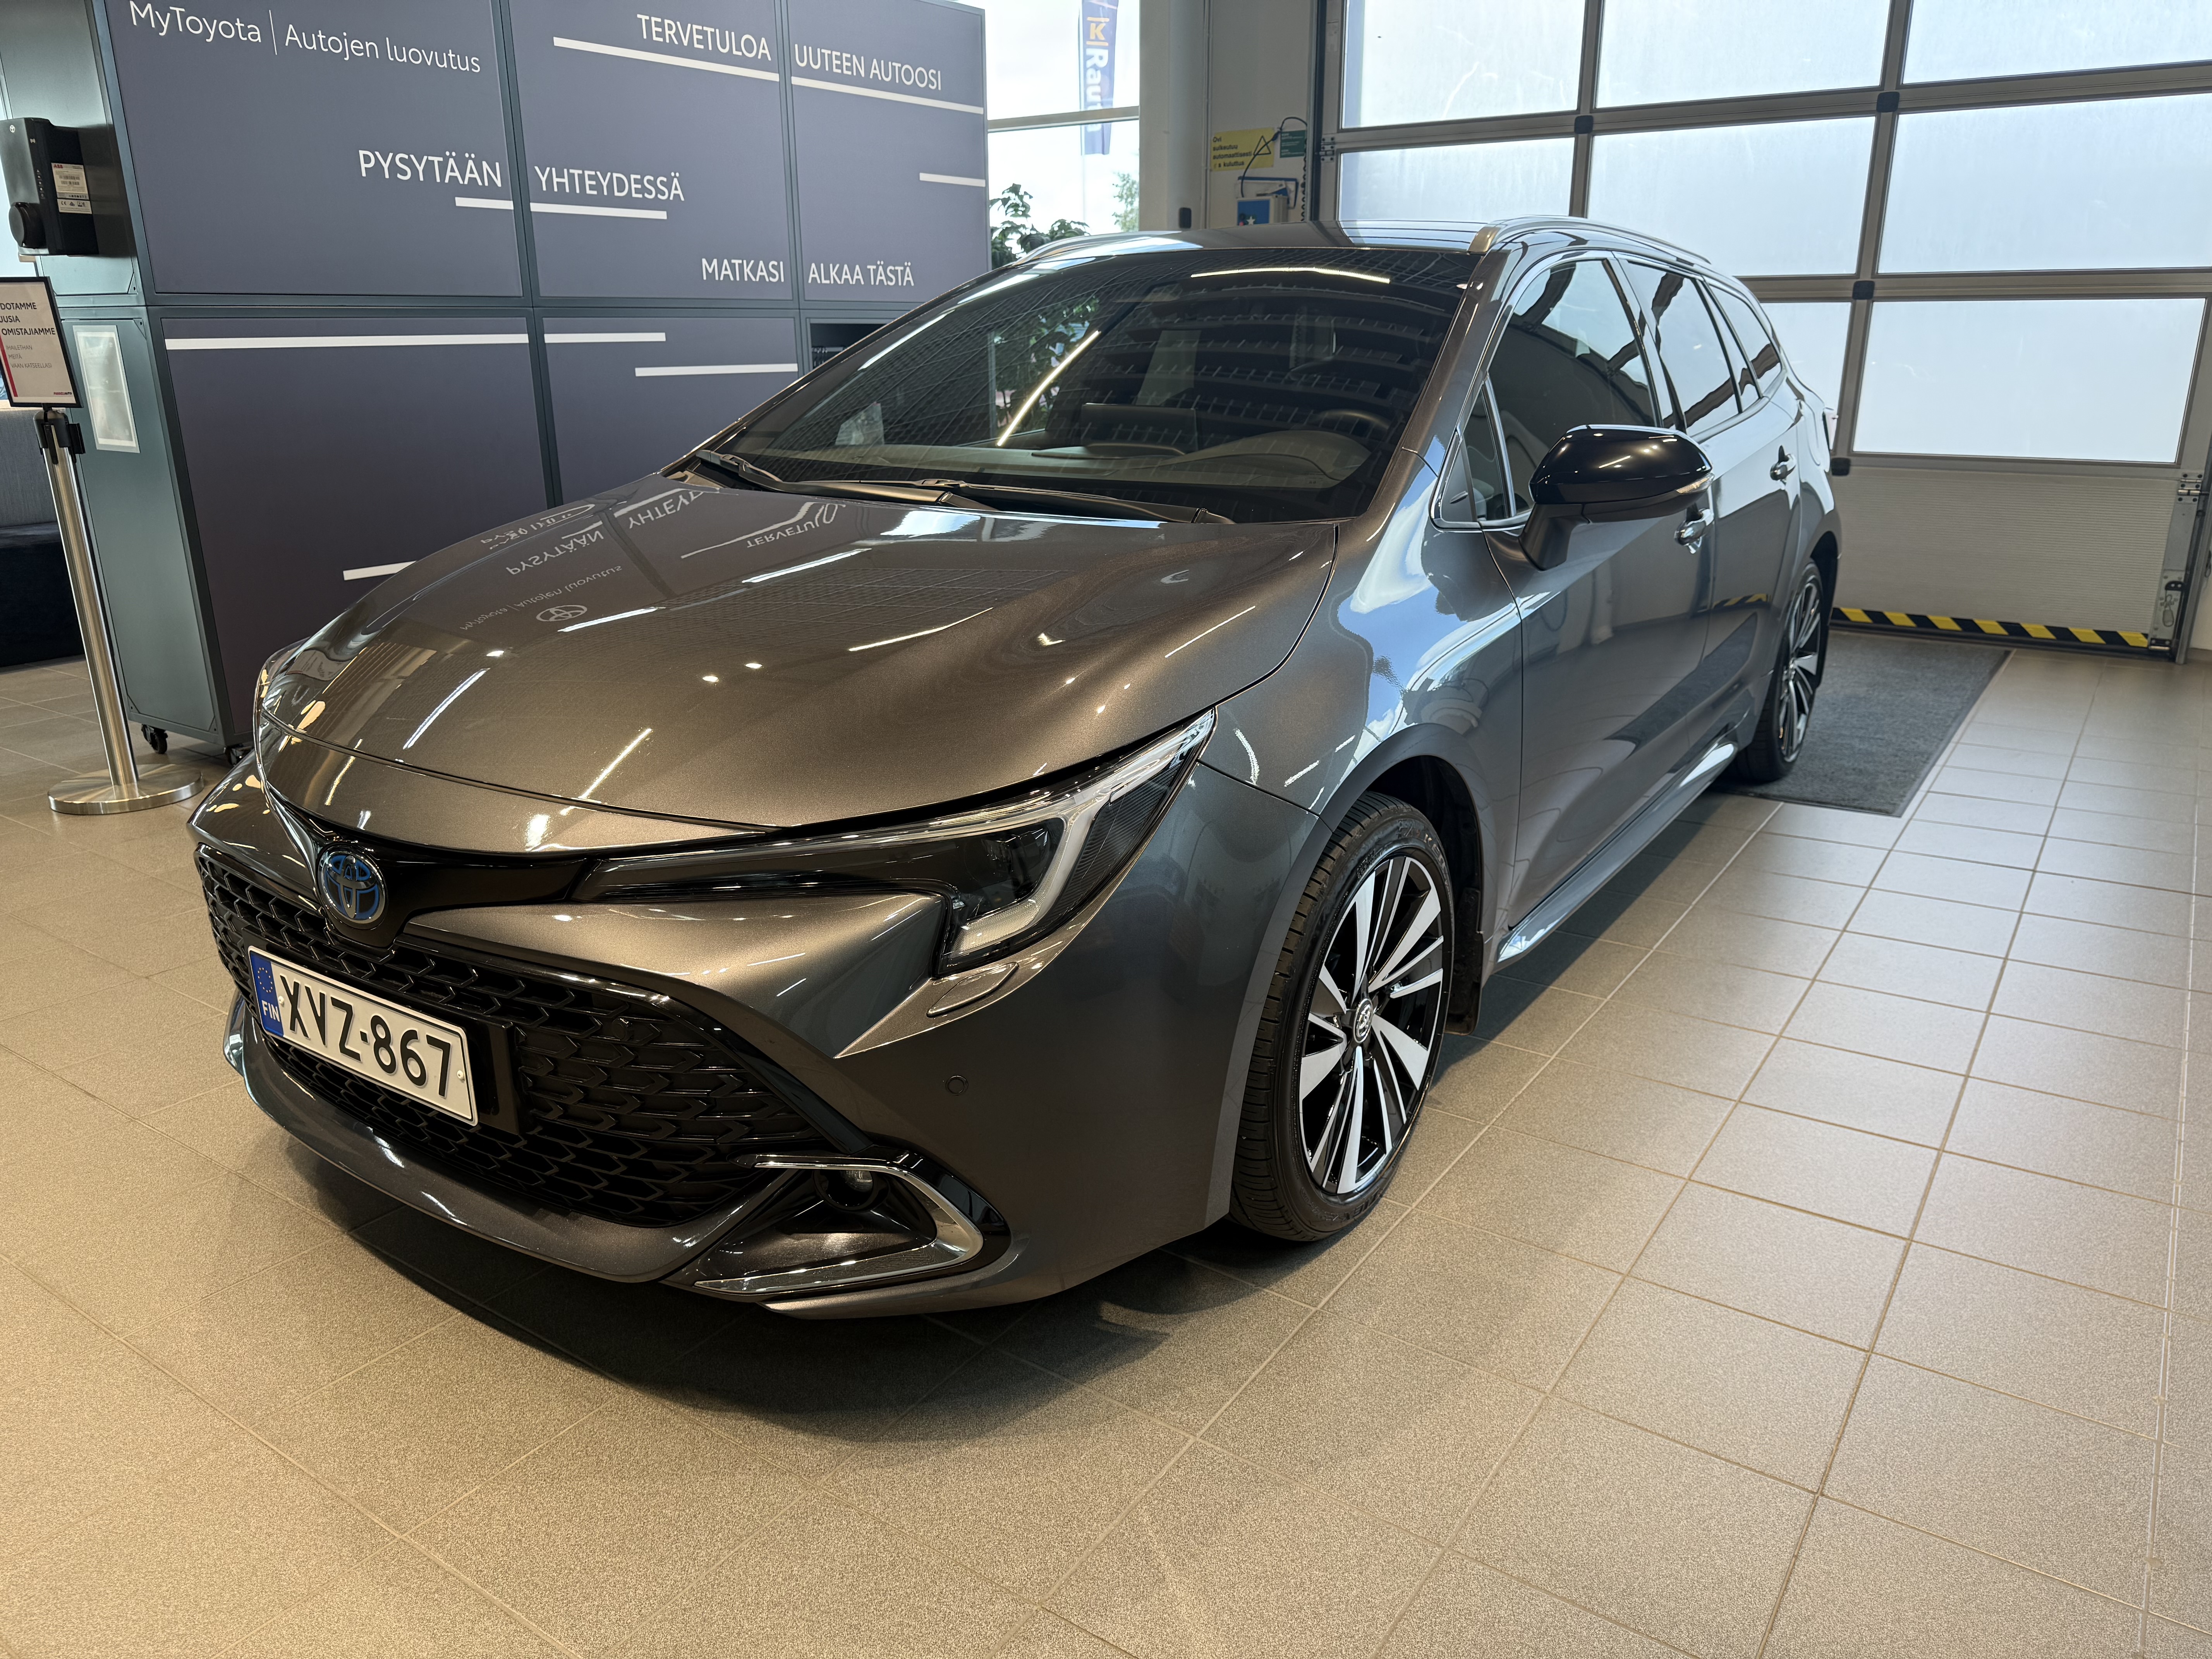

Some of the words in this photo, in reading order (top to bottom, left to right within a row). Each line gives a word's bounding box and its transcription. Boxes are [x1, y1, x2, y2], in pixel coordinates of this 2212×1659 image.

[130, 0, 261, 42] MyToyota
[285, 24, 379, 60] Autojen
[386, 37, 481, 73] luovutus
[637, 14, 771, 61] TERVETULOA
[795, 44, 865, 77] UUTEEN
[869, 58, 941, 91] AUTOOSI
[359, 150, 501, 187] PYSYTÄÄN
[534, 166, 685, 201] YHTEYDESSÄ
[701, 258, 784, 282] MATKASI
[808, 263, 864, 285] ALKAA
[867, 260, 914, 286] TÄSTÄ
[262, 1000, 280, 1022] FIN
[280, 975, 452, 1098] XVZ-867
